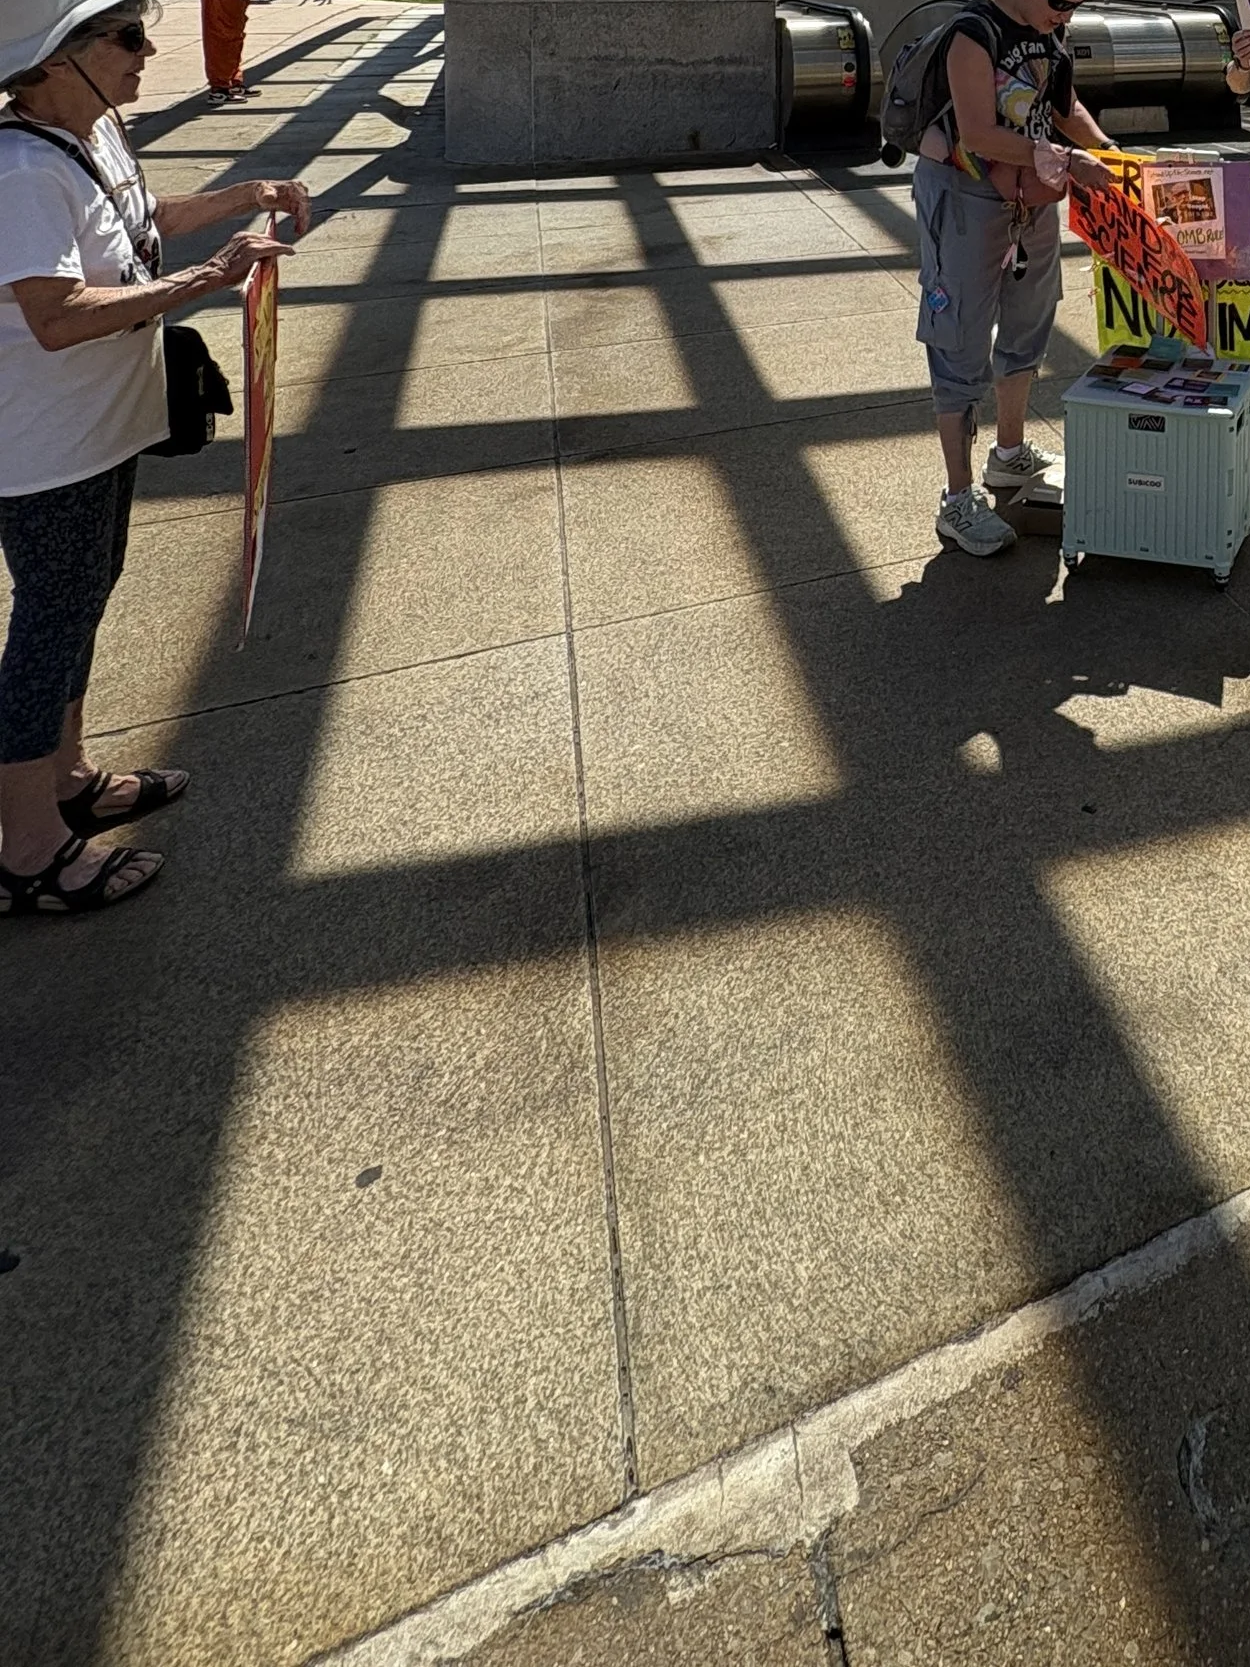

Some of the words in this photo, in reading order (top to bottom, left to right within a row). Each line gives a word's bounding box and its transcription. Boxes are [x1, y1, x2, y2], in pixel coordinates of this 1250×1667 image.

[1000, 45, 1024, 71] big
[1020, 41, 1046, 55] fan
[1177, 227, 1206, 245] OMB
[1078, 205, 1196, 339] SCIENCE
